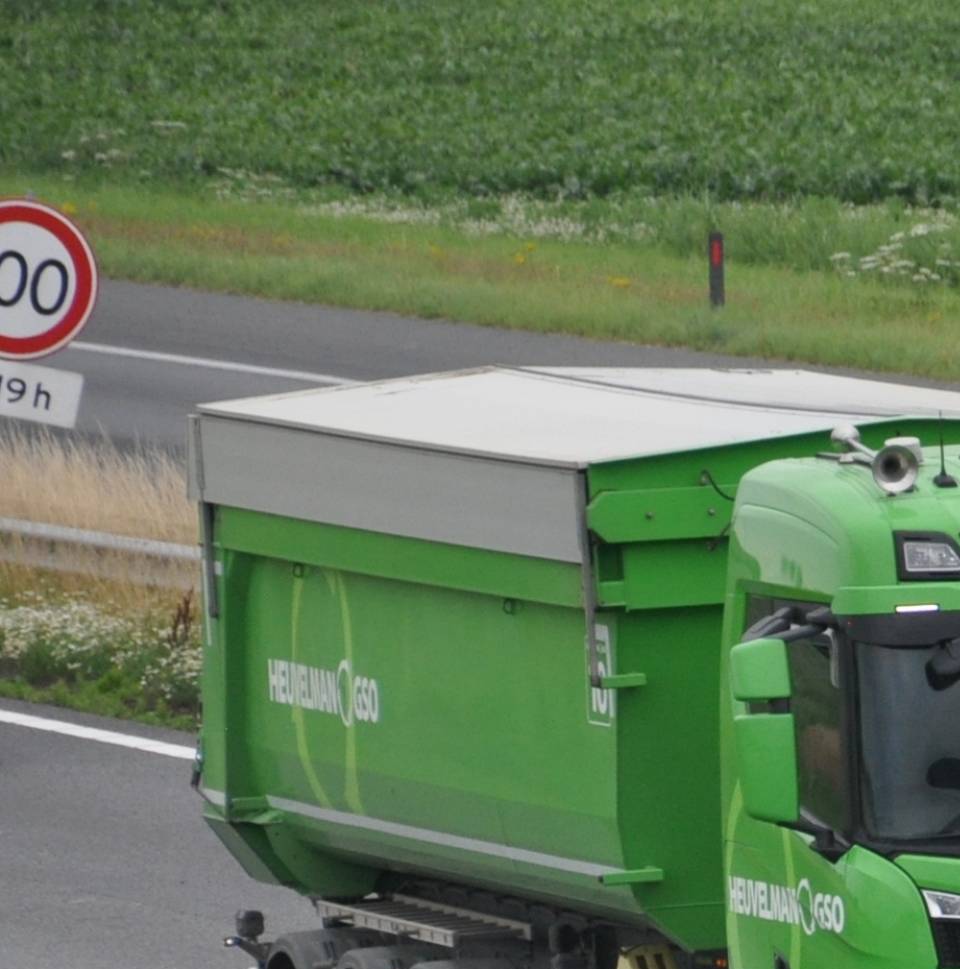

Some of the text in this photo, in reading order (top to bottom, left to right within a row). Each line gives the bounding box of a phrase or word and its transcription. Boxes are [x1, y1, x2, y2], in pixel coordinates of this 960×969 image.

[268, 658, 379, 723] HEUVELMAN GSO
[728, 874, 845, 934] HEUVELMAN GSO
